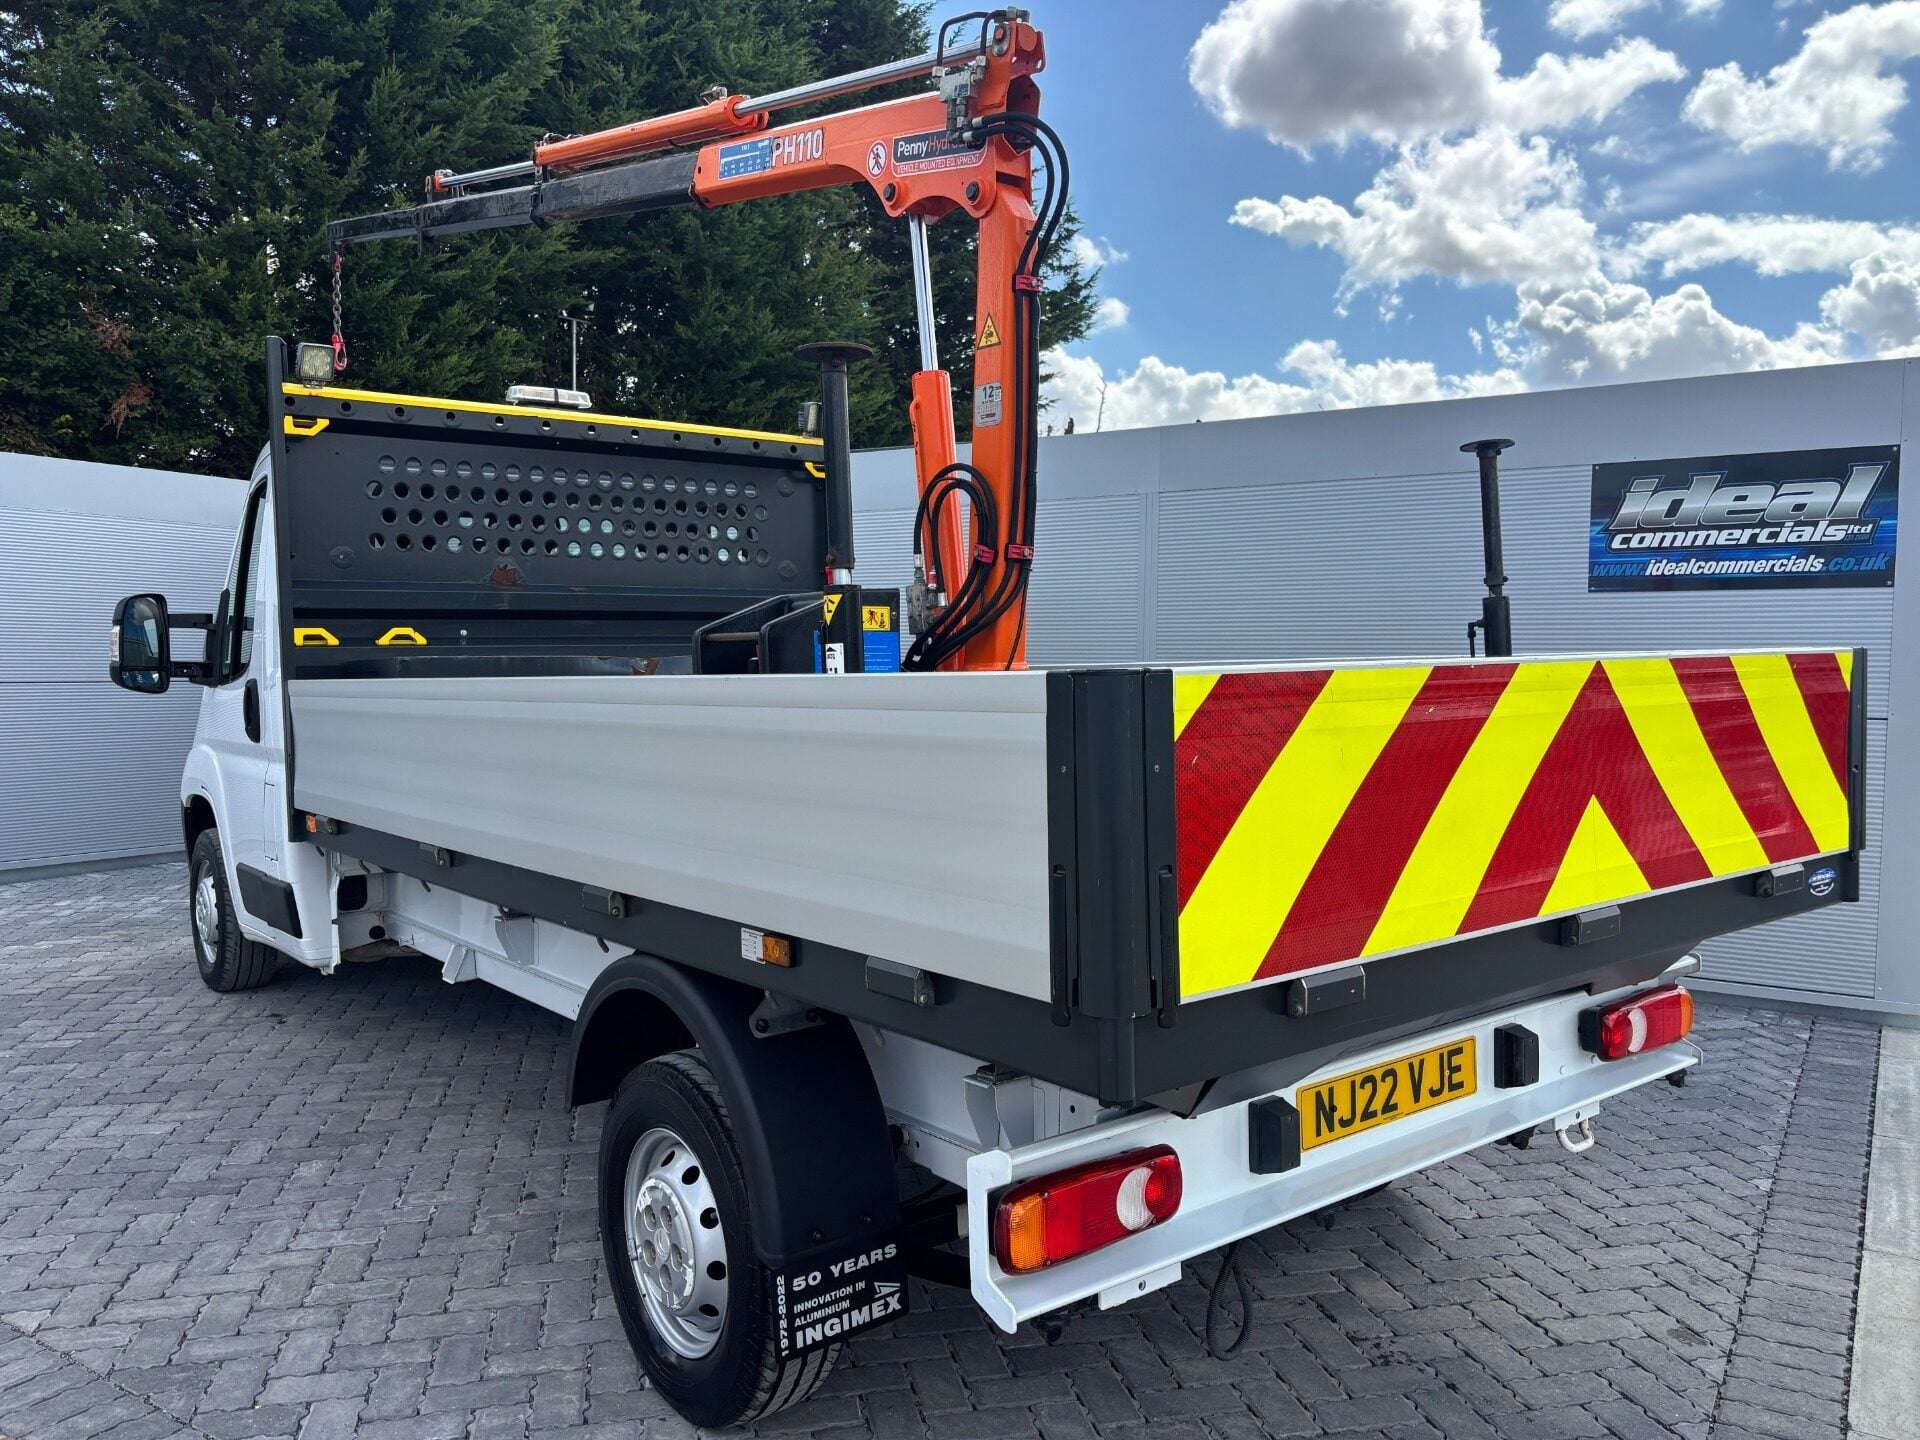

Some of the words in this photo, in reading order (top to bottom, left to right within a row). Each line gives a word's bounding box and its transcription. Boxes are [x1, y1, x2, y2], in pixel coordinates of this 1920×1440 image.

[771, 127, 824, 169] PH110
[897, 140, 929, 158] Penny
[920, 160, 946, 171] MOUNTED
[1608, 463, 1886, 530] ideal
[1610, 520, 1848, 550] commercials
[1846, 523, 1873, 534] ltd
[1592, 553, 1889, 577] www.idealcommercials.co.uk
[1314, 1067, 1399, 1138] NJ22
[1408, 1046, 1464, 1105] VJE
[792, 1271, 822, 1292] 50
[829, 1243, 898, 1278] YEARS
[776, 1274, 790, 1357] 1972-2022
[793, 1284, 853, 1314] INNOVATION
[855, 1280, 867, 1292] IN
[794, 1299, 851, 1328] ALUMINIUM
[795, 1292, 902, 1350] INGIMEX
